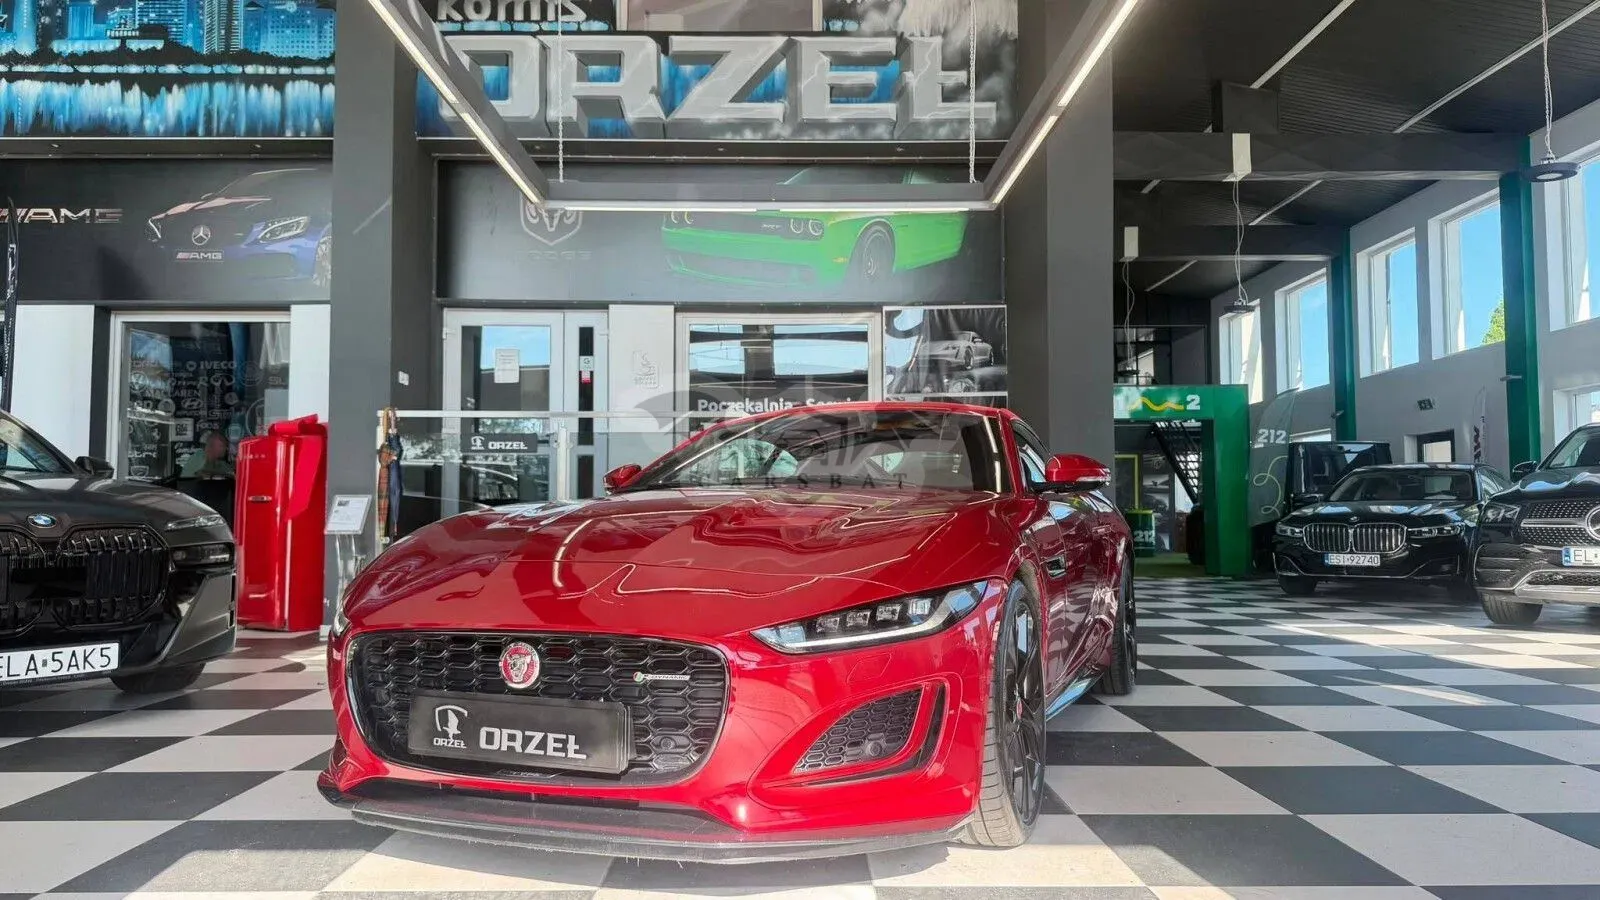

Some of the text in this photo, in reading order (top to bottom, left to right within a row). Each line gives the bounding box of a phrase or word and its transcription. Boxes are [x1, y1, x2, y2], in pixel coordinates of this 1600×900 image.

[438, 34, 997, 130] ORZEŁ
[697, 397, 793, 413] Poczekalnia
[1257, 428, 1287, 444] 212
[488, 441, 528, 450] ORZEŁ
[51, 646, 111, 673] 5AK5
[433, 737, 467, 749] ORZEŁ
[479, 726, 587, 760] ORZEŁ
